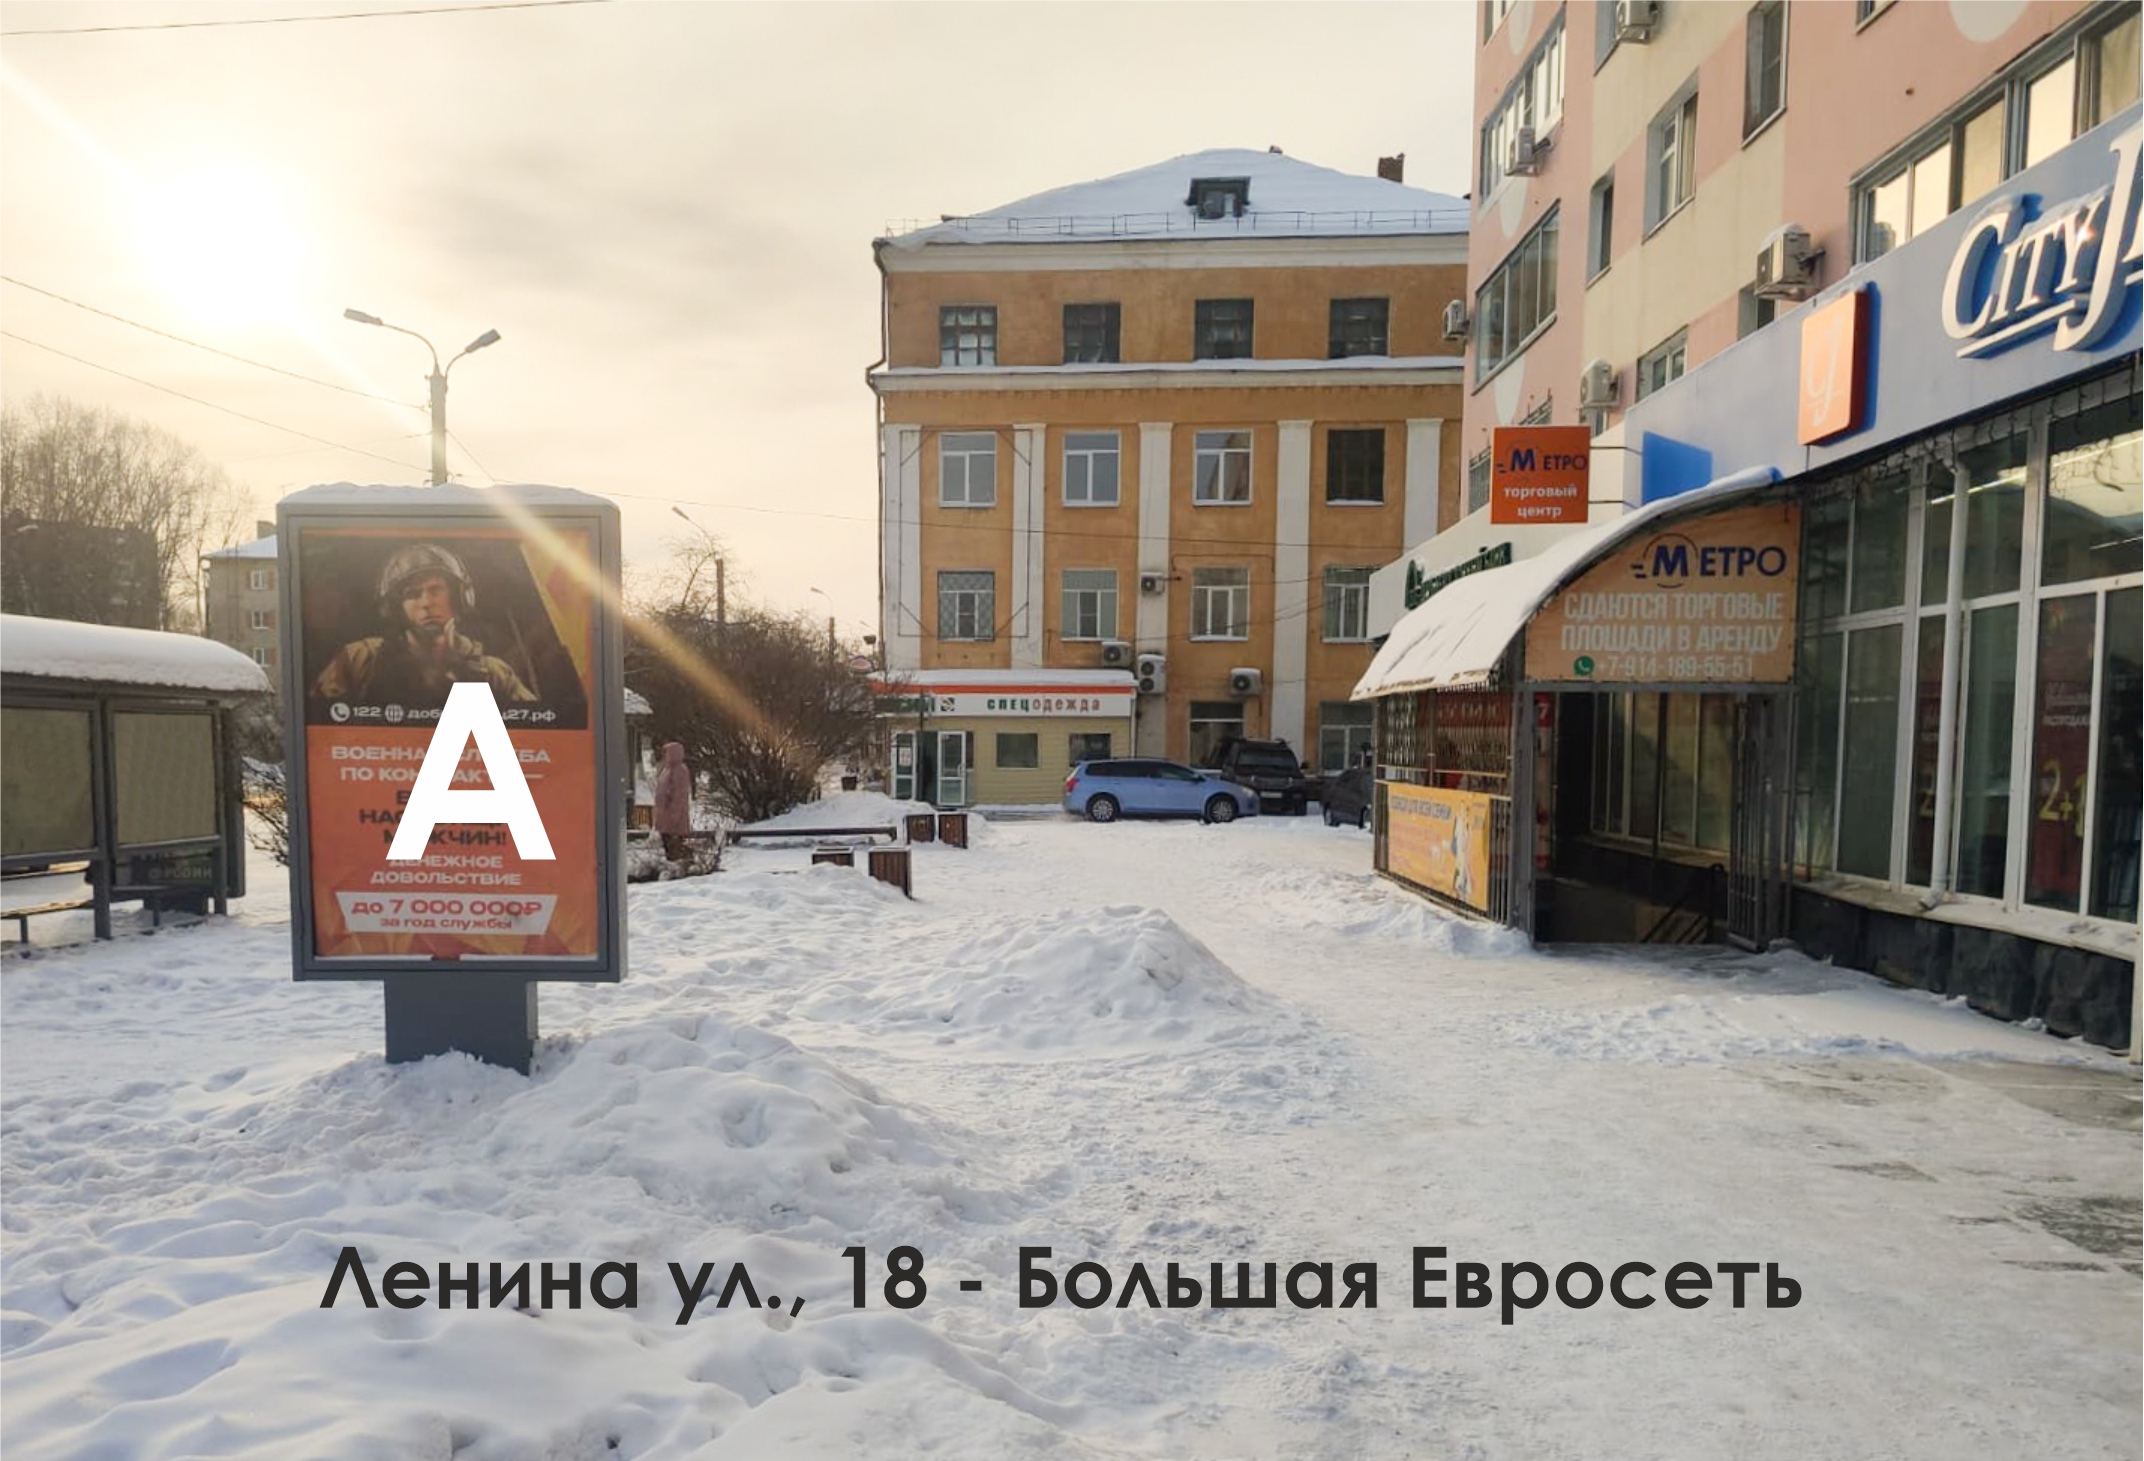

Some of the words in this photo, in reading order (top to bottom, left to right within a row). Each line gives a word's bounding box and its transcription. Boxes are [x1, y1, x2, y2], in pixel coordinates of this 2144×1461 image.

[1504, 483, 1578, 501] торговый
[1517, 506, 1562, 518] центр
[1563, 592, 1668, 622] СДАЮТСЯ
[1673, 592, 1784, 620] ТОРГОВЫЕ
[1560, 624, 1671, 655] ПЛОЩАДИ
[1678, 625, 1691, 650] В
[1696, 625, 1784, 655] АРЕНДУ
[353, 707, 382, 718] 122
[331, 745, 428, 761] ВОЕННА
[340, 766, 374, 781] ПО
[389, 855, 503, 868] ДЕНЕЖНОЕ
[370, 871, 522, 886] ДОВОЛЬСТВИЕ
[352, 902, 384, 916] до
[389, 900, 404, 914] 7
[411, 900, 464, 915] 000
[381, 918, 400, 928] за
[404, 918, 435, 929] год
[440, 917, 512, 931] службы
